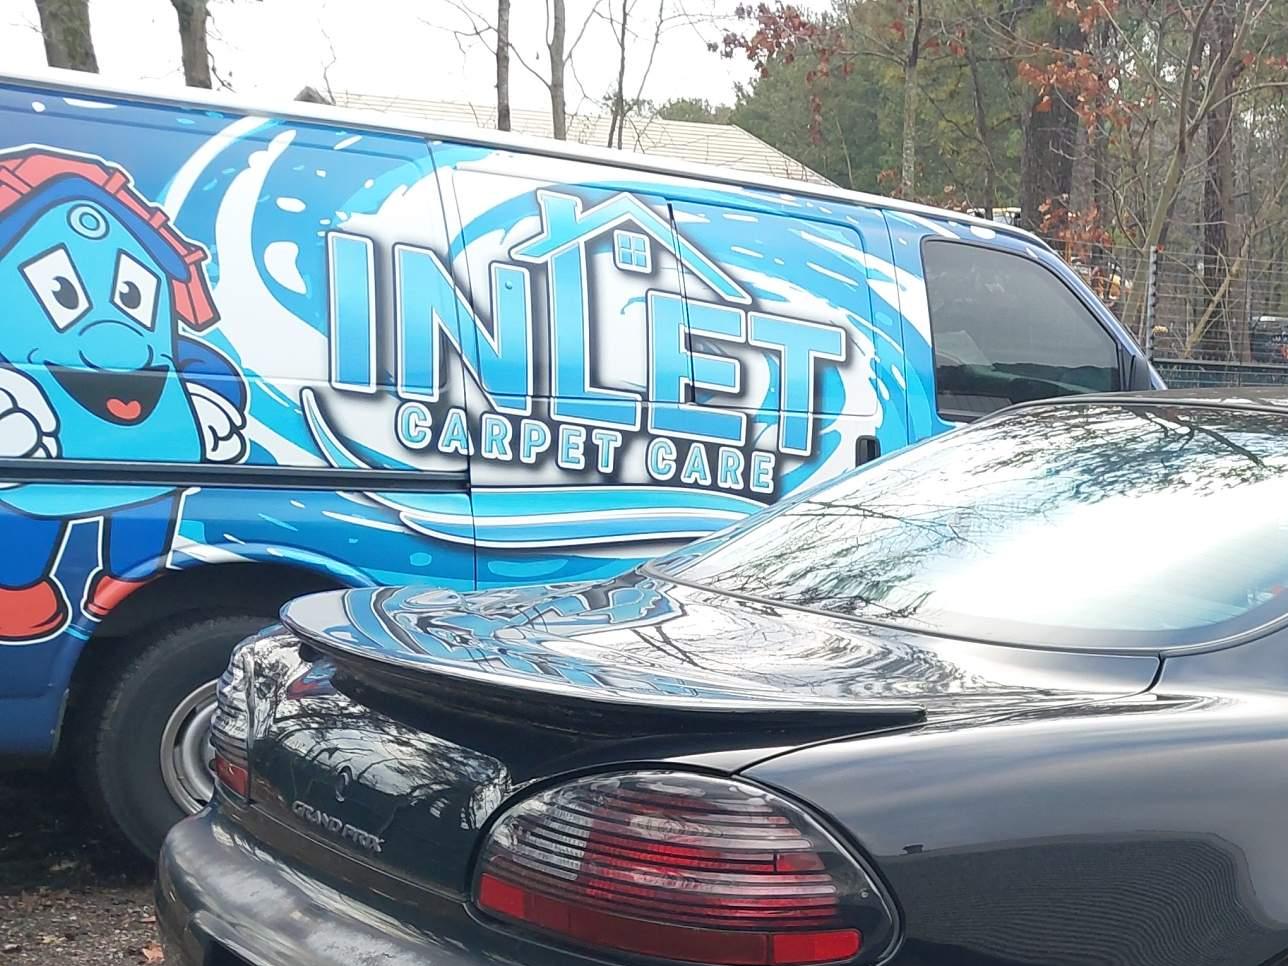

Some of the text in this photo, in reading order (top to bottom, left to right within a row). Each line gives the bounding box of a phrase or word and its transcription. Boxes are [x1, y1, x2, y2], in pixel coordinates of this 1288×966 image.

[327, 230, 847, 456] INLET
[396, 402, 776, 494] CARPET CARE
[292, 800, 384, 852] GRAND PRIX
